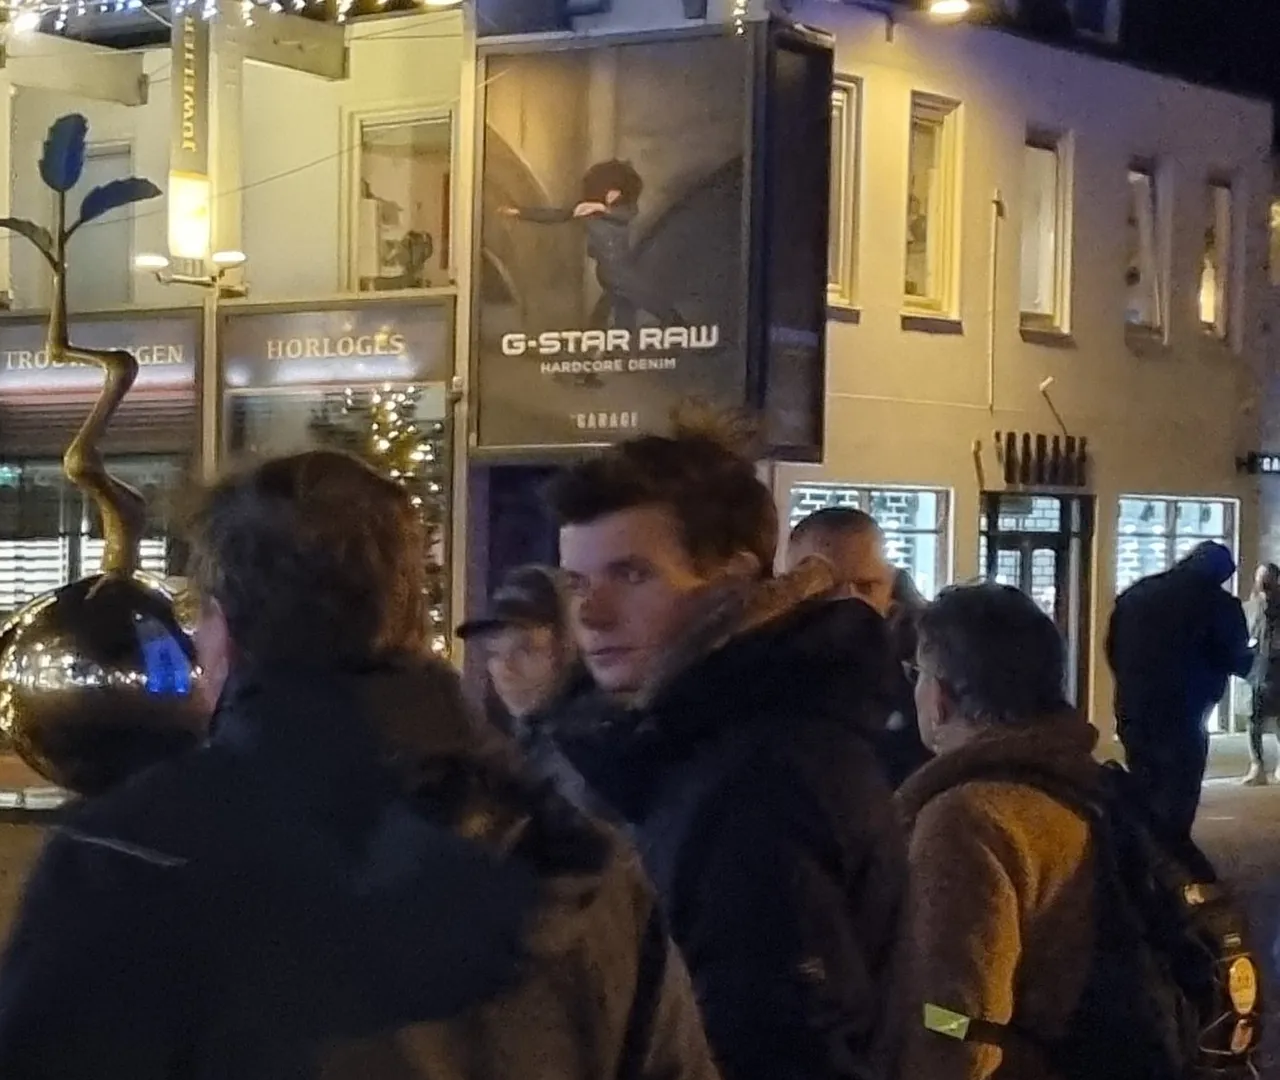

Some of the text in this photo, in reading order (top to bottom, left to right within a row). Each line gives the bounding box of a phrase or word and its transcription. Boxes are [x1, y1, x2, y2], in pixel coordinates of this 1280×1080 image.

[266, 333, 407, 360] HORLOGES
[502, 324, 720, 356] G-STAR RAW
[540, 357, 676, 374] HARDCORE DENIM
